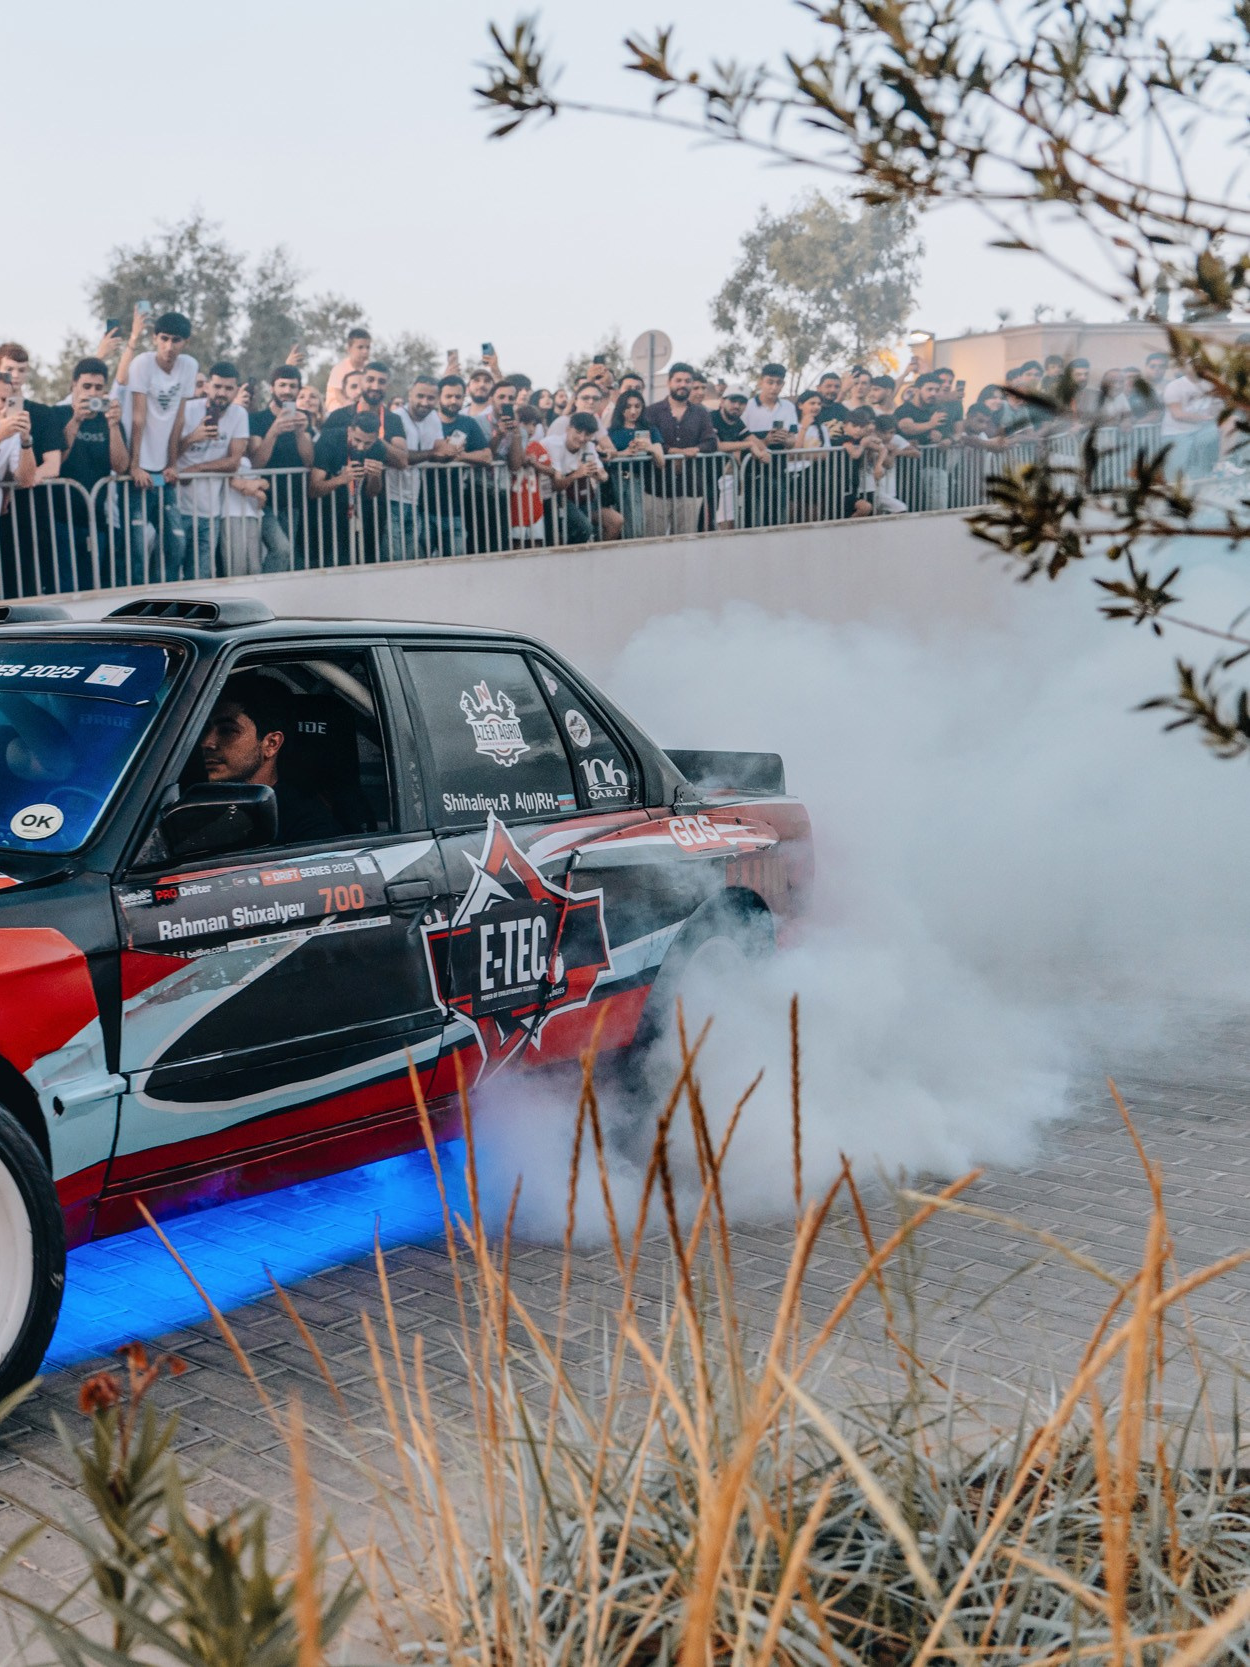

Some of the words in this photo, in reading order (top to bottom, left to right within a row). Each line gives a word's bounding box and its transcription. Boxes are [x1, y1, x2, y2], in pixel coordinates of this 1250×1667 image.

[21, 665, 86, 679] 2025
[297, 721, 328, 735] IDE
[473, 723, 498, 741] AZER
[497, 723, 521, 741] AGRO
[579, 758, 628, 787] 106
[442, 792, 511, 811] Shihaliev.R
[21, 814, 55, 829] OK
[668, 814, 722, 847] GDS
[272, 869, 299, 881] DRIFT
[299, 865, 332, 878] SERIES
[331, 862, 356, 874] 2025
[155, 888, 178, 900] PRO
[317, 883, 365, 914] 700
[158, 915, 229, 941] Rahman
[232, 901, 306, 928] Shixalyev
[479, 914, 555, 991] E-TEC
